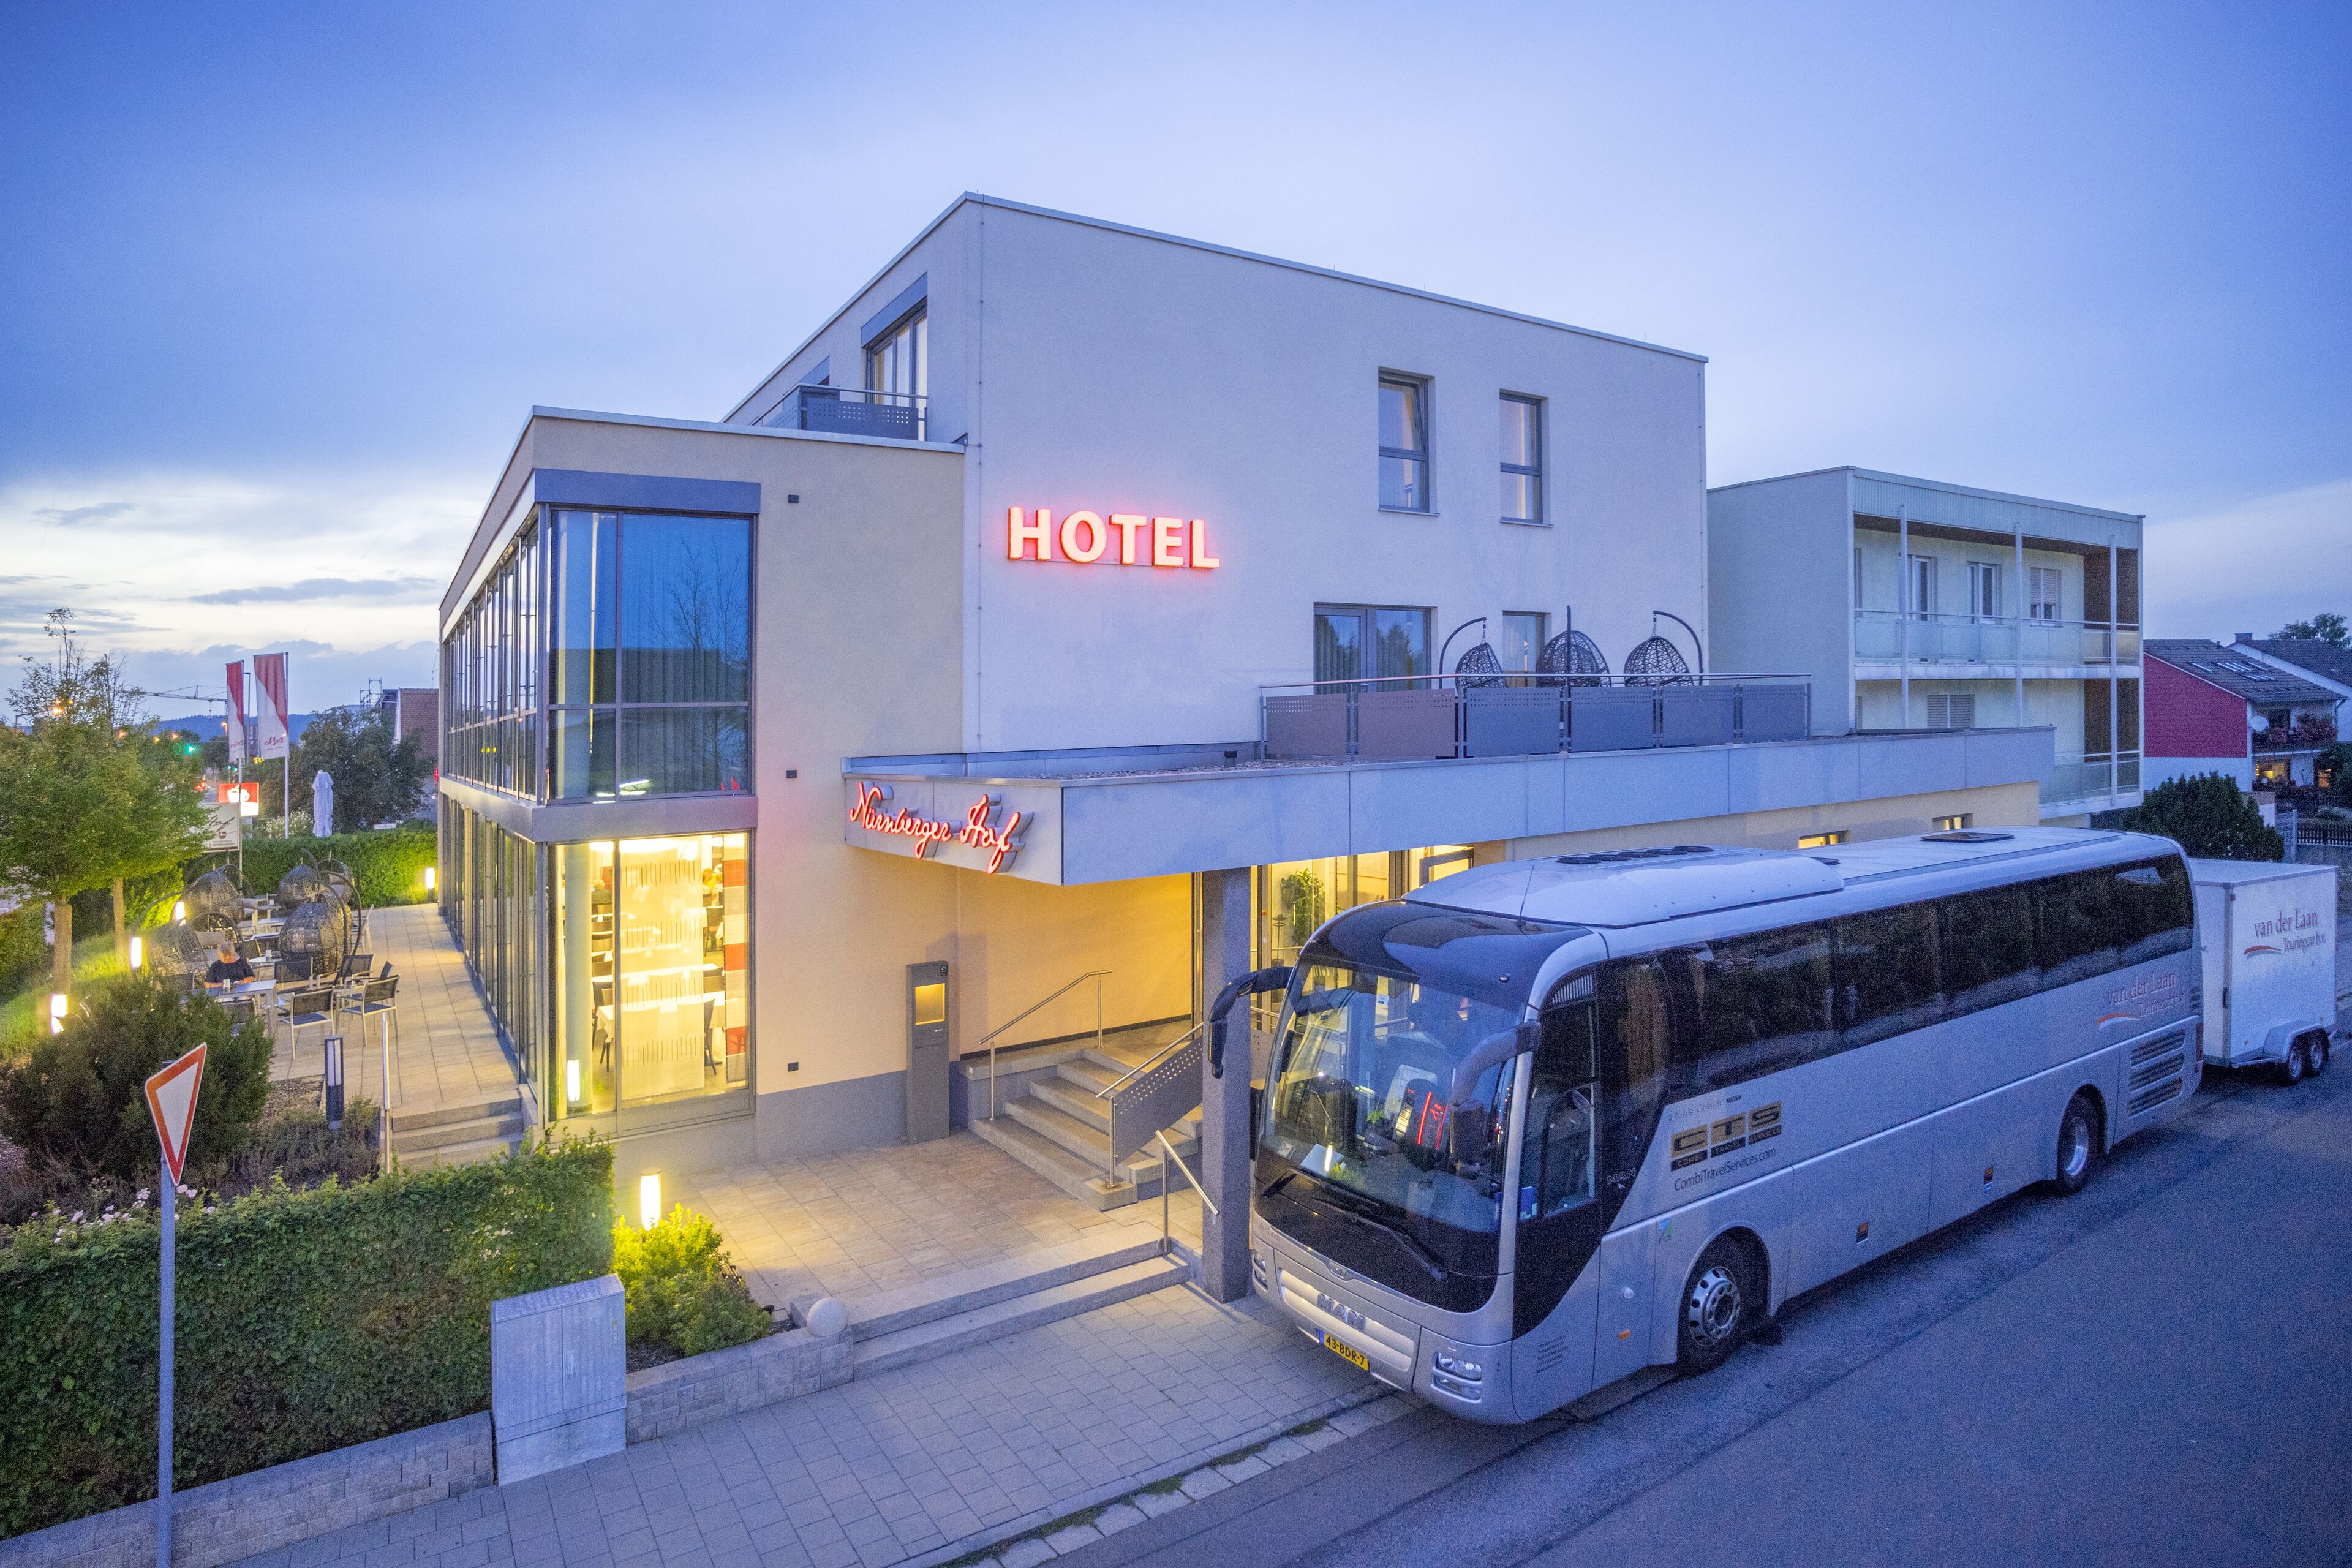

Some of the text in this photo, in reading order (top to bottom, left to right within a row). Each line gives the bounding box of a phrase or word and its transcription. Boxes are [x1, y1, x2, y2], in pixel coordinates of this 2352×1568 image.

[1008, 507, 1220, 568] HOTEL
[850, 782, 1020, 874] Nürnberger Hof
[2253, 908, 2318, 938] van der Laan
[2107, 972, 2176, 1006] van der Laan
[1673, 1104, 1780, 1152] CTS
[1607, 1167, 1636, 1185] MAN
[1674, 1148, 1776, 1191] CombiTravelServices.com
[1317, 1292, 1366, 1330] MAN
[1325, 1335, 1365, 1366] 43-BDR-7
